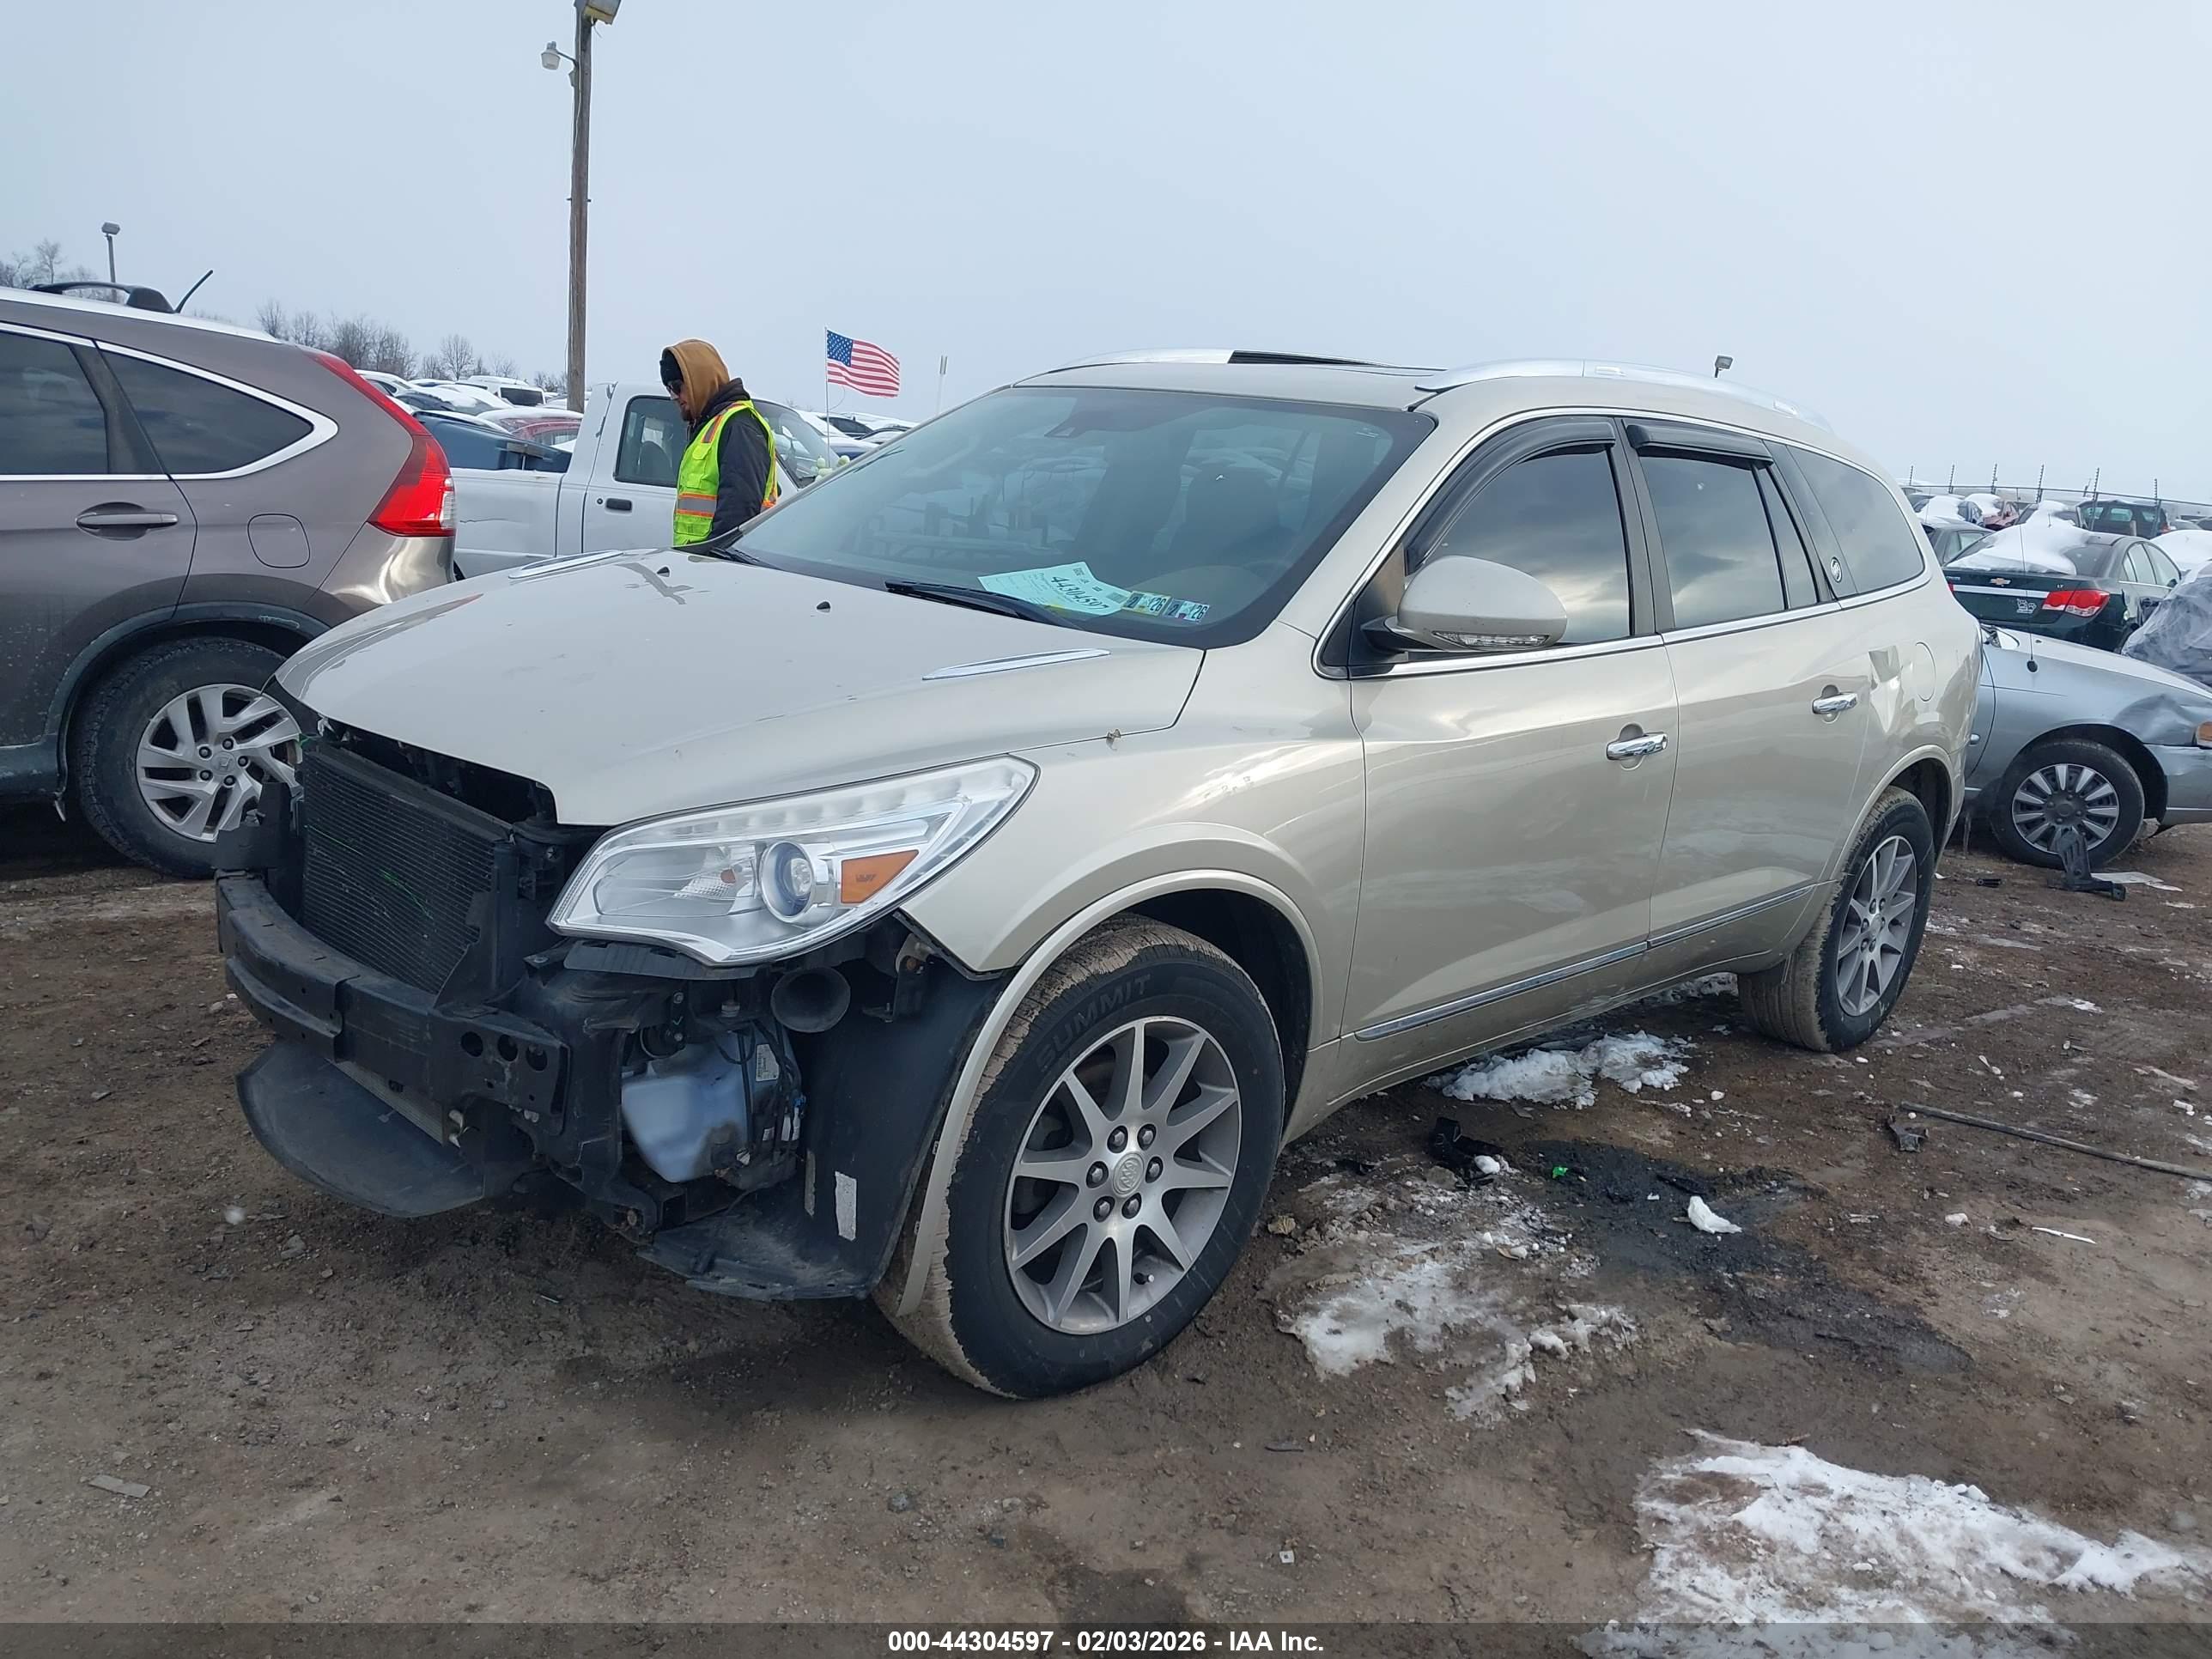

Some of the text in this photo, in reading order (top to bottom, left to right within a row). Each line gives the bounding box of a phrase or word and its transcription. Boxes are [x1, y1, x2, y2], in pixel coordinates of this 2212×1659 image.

[1050, 576, 1109, 610] 44304597
[1127, 596, 1139, 609] 2
[1168, 604, 1180, 616] 2
[1036, 973, 1151, 1073] SUMMIT
